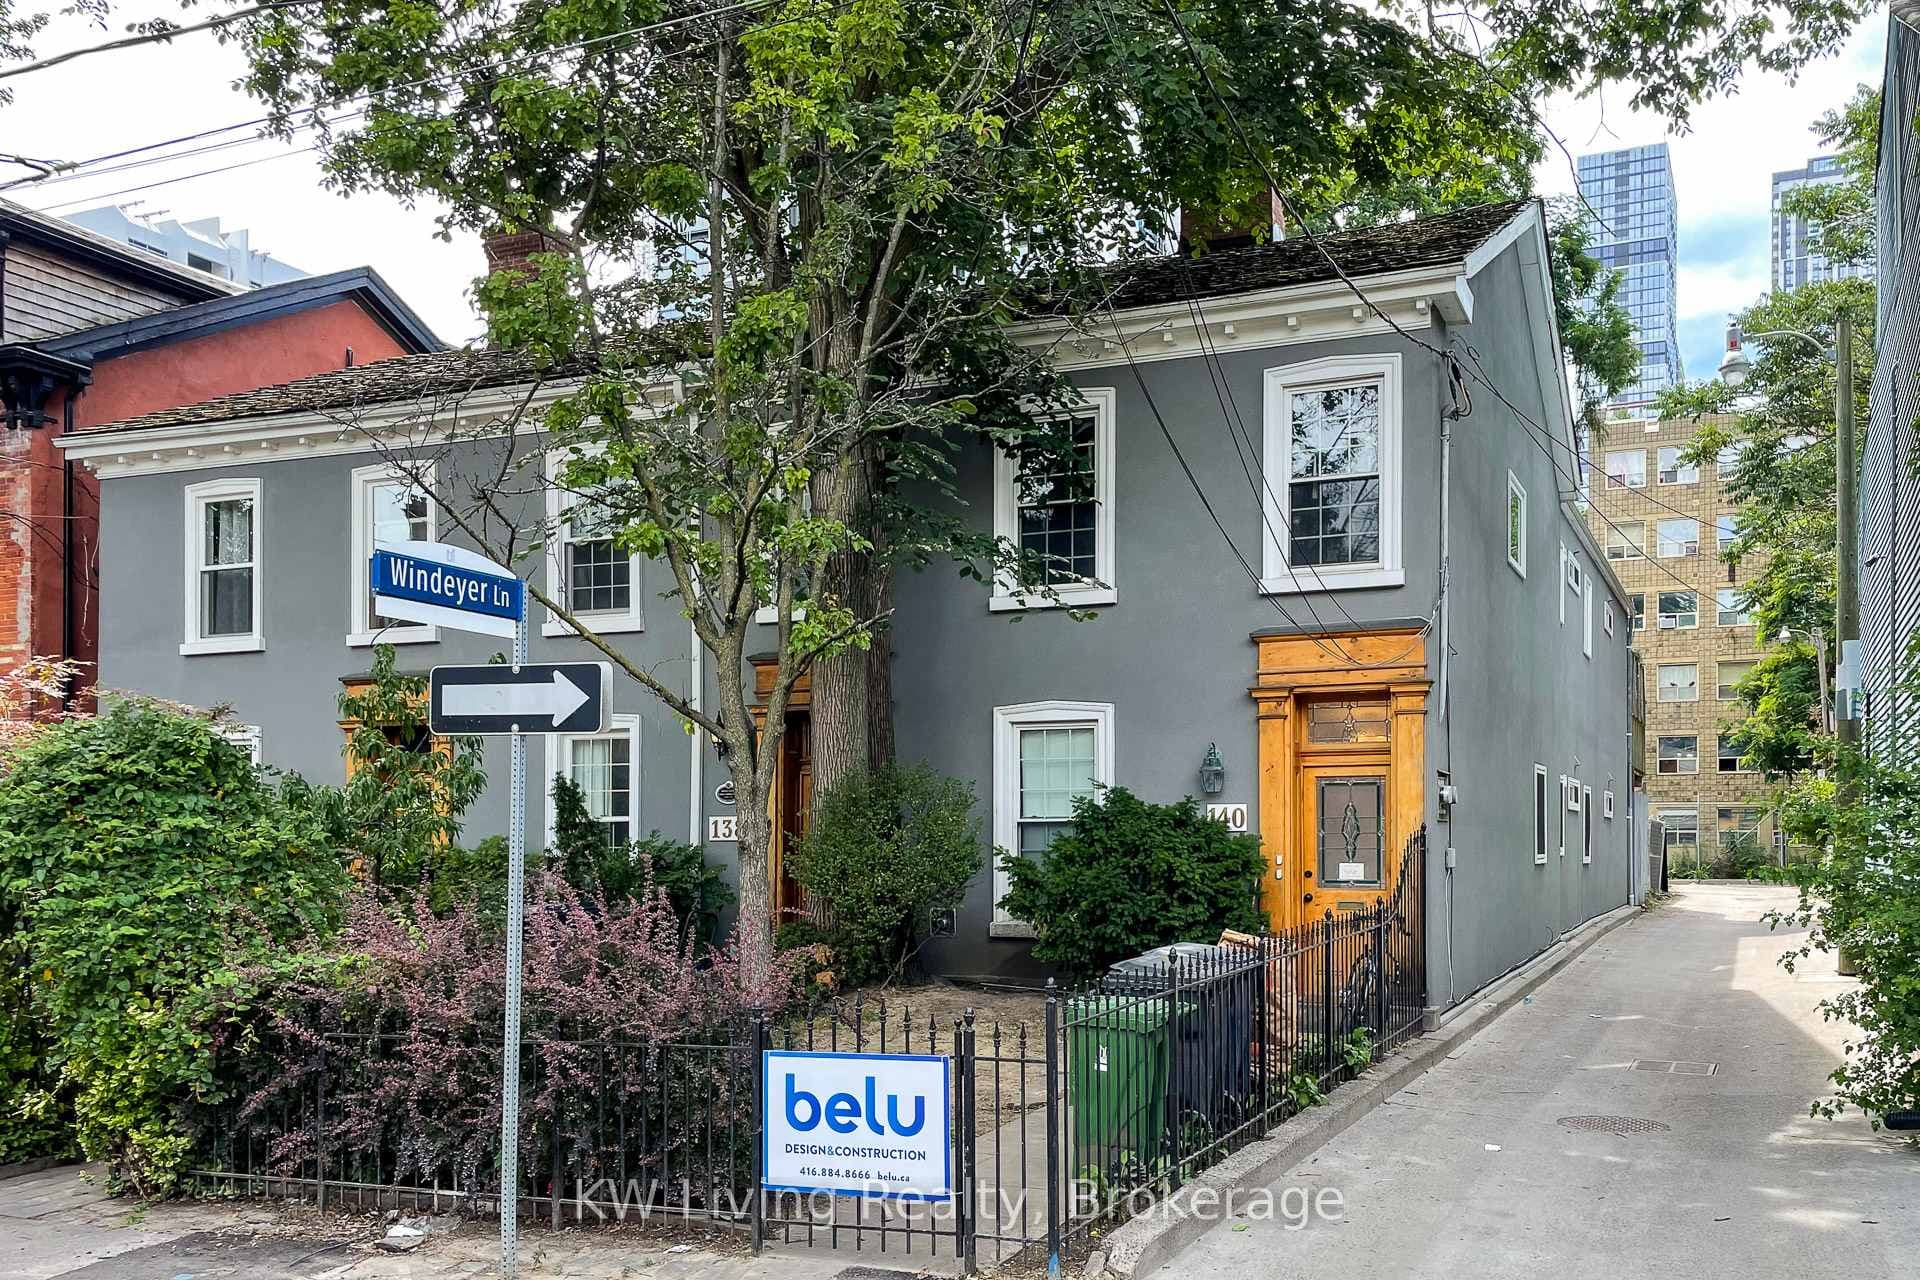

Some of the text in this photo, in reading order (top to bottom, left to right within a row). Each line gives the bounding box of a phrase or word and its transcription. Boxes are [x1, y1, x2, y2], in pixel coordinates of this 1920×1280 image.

[390, 557, 510, 608] Windeyer Ln
[1207, 807, 1246, 829] 140
[711, 819, 738, 839] 13
[785, 1072, 926, 1137] belu
[785, 1143, 927, 1161] DESIGN&CONSTRUCTION
[799, 1166, 910, 1182] 416.884.8666 belu.ca
